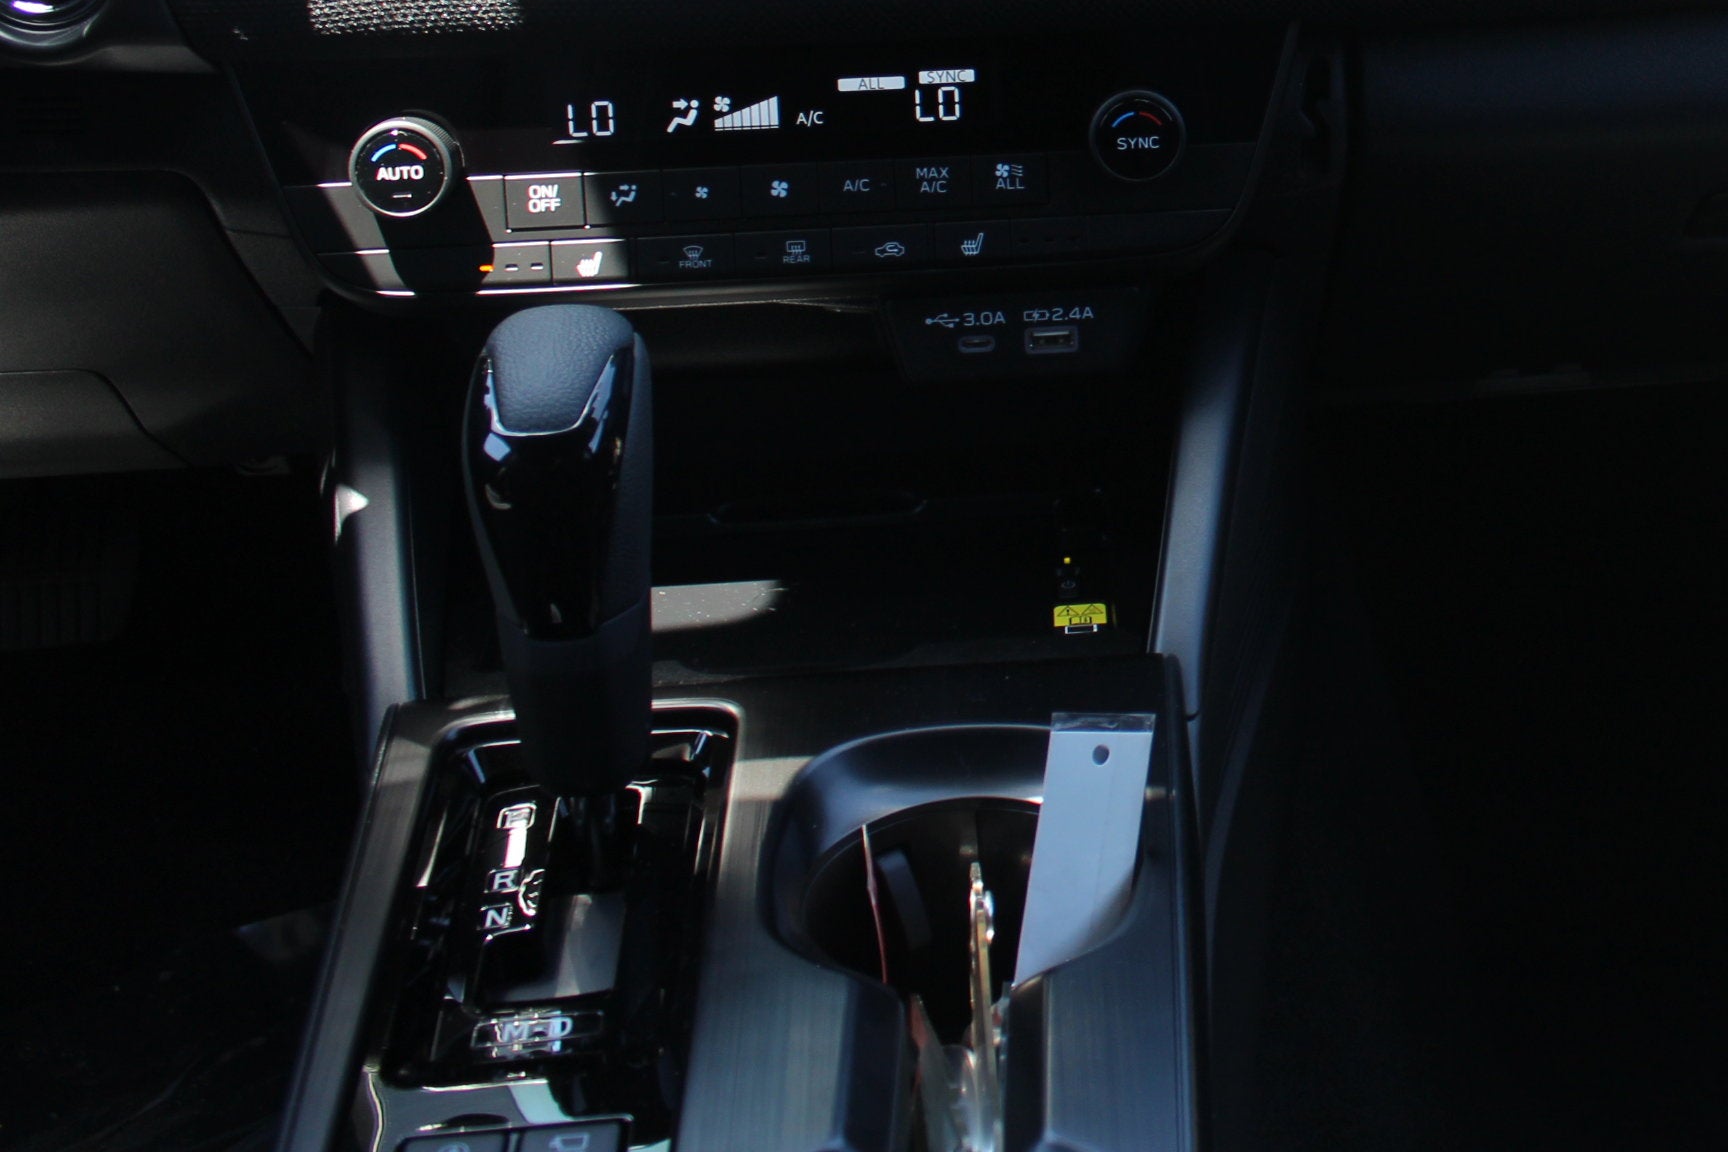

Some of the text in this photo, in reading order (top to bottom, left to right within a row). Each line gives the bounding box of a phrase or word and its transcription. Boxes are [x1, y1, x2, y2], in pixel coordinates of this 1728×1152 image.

[857, 78, 886, 90] ALL
[927, 70, 967, 84] SYNC
[915, 86, 960, 121] LO
[566, 101, 614, 136] LO
[796, 111, 824, 125] A/C
[1117, 136, 1159, 150] SYNC
[376, 165, 424, 181] AUTO
[916, 167, 949, 179] MAX
[843, 178, 870, 191] A/C
[920, 180, 947, 193] A/C
[996, 177, 1025, 189] ALL
[528, 184, 558, 198] ON/
[528, 198, 560, 212] OFF
[679, 259, 713, 268] FRONT
[782, 255, 810, 263] REAR
[963, 312, 1006, 327] 3.0A
[1051, 307, 1094, 322] 2.4A
[493, 870, 517, 889] R
[485, 908, 508, 927] N
